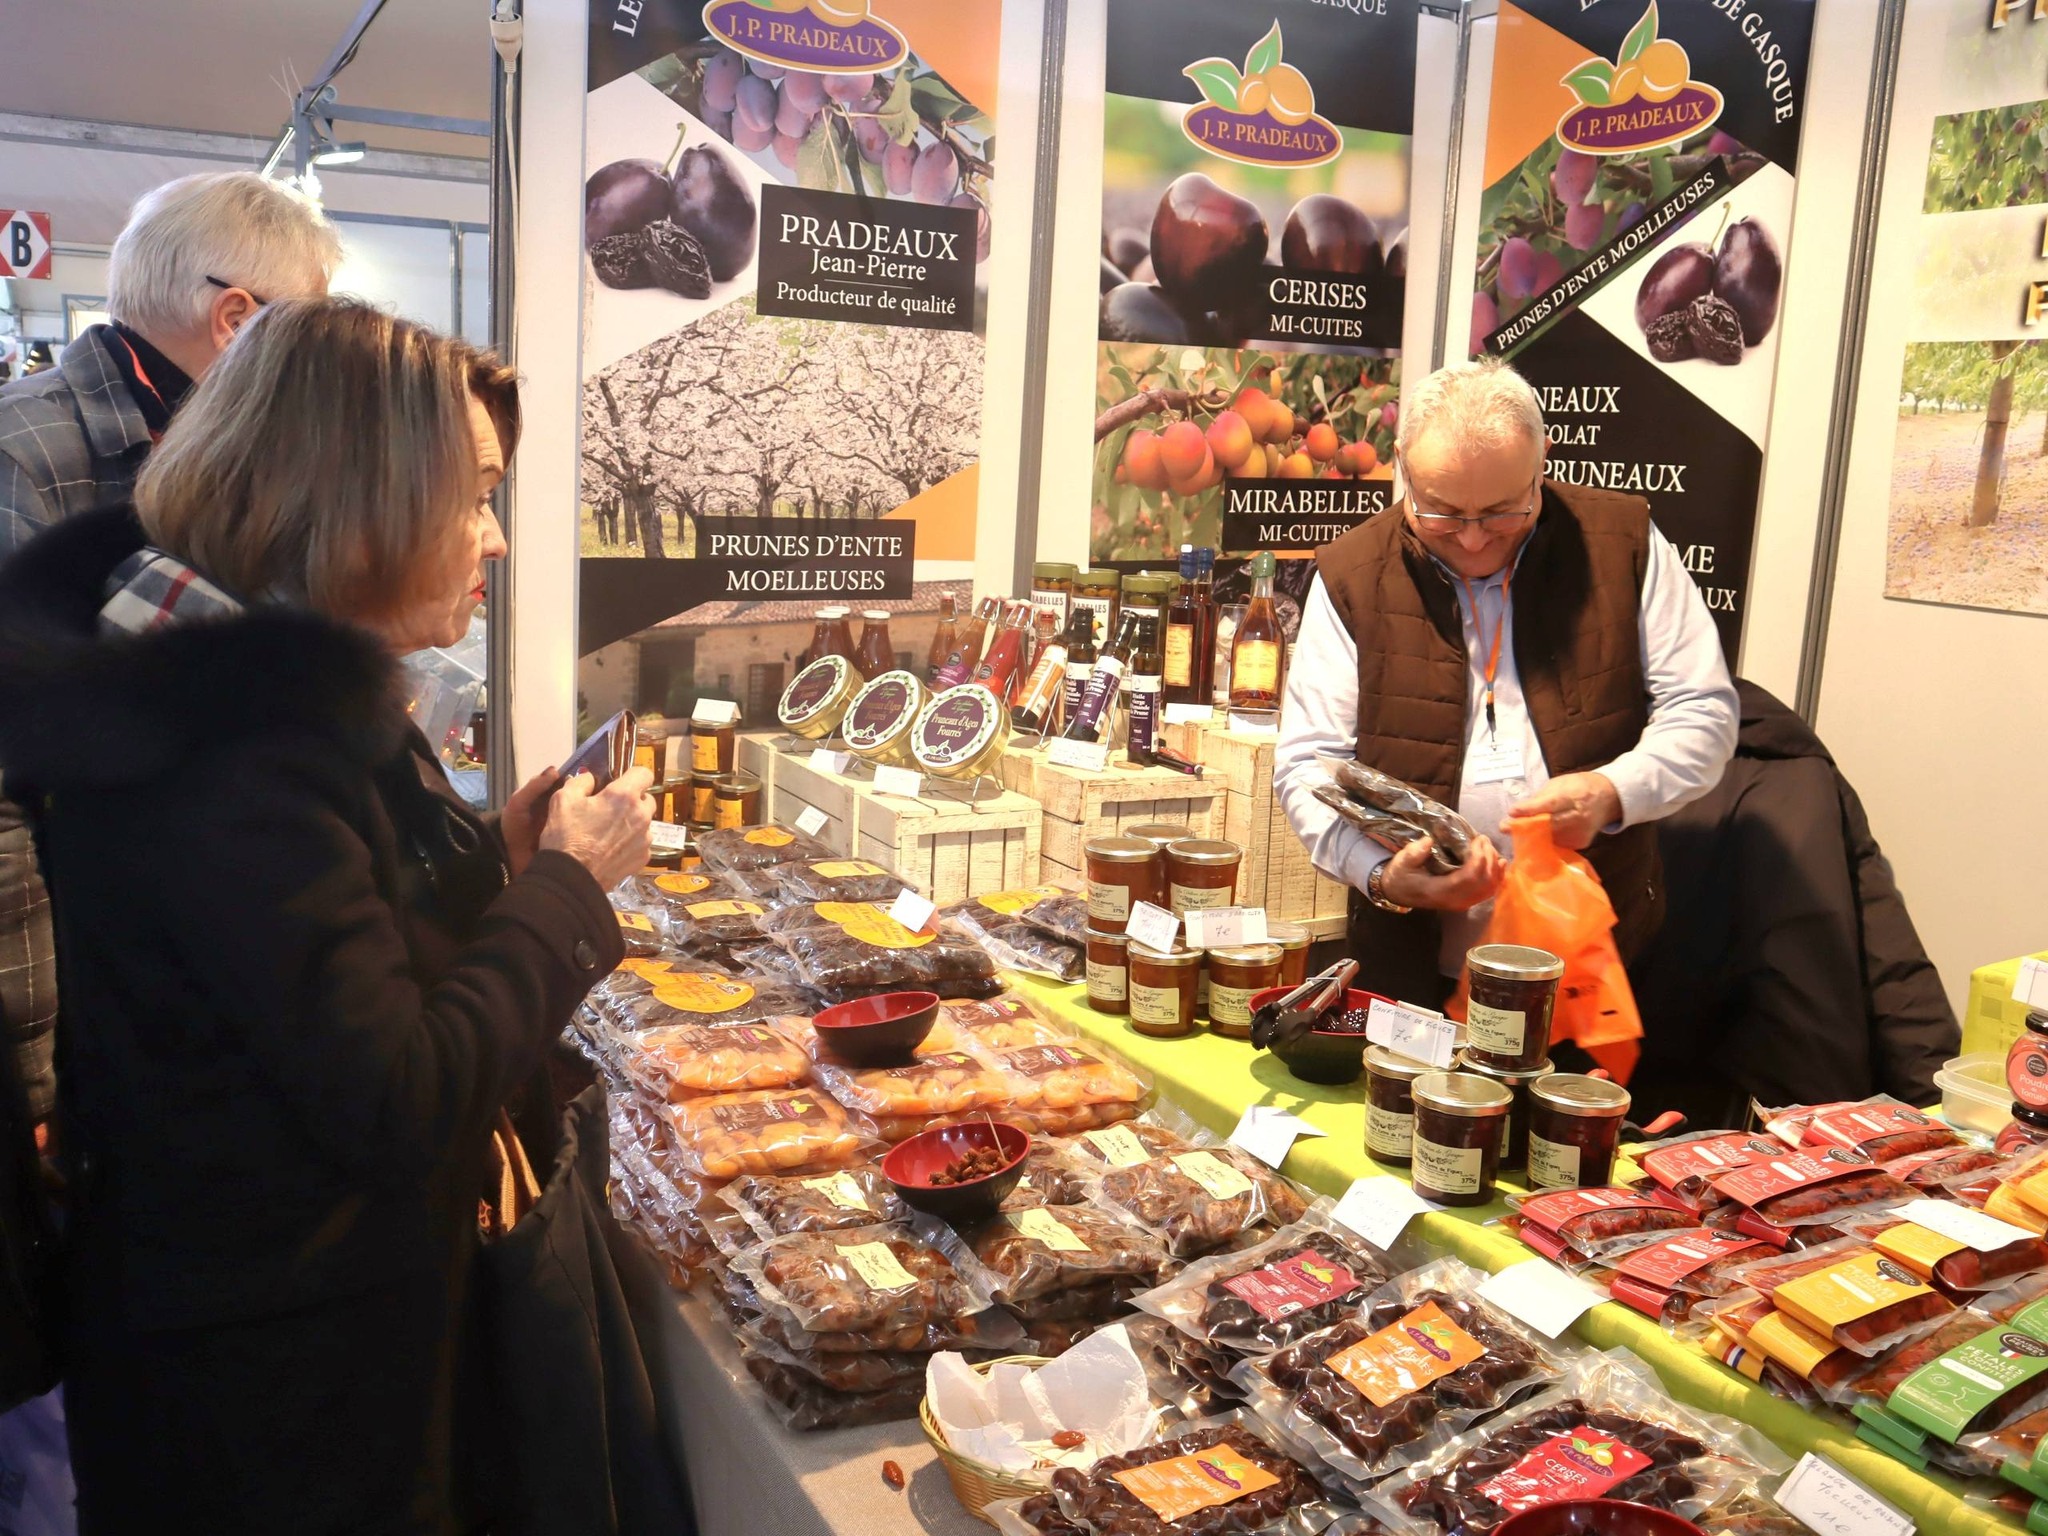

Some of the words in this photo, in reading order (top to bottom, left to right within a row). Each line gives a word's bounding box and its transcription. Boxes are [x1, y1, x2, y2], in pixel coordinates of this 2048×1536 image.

[728, 14, 743, 38] J.
[747, 17, 764, 40] P.
[769, 22, 890, 59] PRADEAUX
[1741, 12, 1794, 124] GASQUE
[1201, 118, 1214, 140] J.
[1217, 121, 1231, 140] P.
[1235, 122, 1328, 153] PRADEAUX
[1574, 120, 1587, 142] J.
[1589, 118, 1602, 137] P.
[1605, 99, 1705, 134] PRADEAUX
[11, 220, 32, 268] B
[778, 213, 959, 262] PRADEAUX
[811, 248, 927, 282] Jean-Pierre
[1495, 299, 1552, 350] PRUNES
[1553, 254, 1610, 307] D'ENTE
[1609, 172, 1717, 264] MOELLEUSES
[776, 281, 873, 309] Producteur
[876, 284, 898, 310] de
[901, 287, 957, 319] qualité
[1269, 277, 1367, 310] CERISES
[1269, 313, 1363, 339] MI-CUITES
[1228, 489, 1385, 515] MIRABELLES
[709, 533, 810, 557] PRUNES
[815, 535, 902, 558] D'ENTE
[725, 569, 886, 592] MOELLEUSES
[930, 712, 959, 726] Pruneaux
[958, 715, 979, 731] d'Agen
[936, 725, 963, 738] Fourrés
[1504, 1039, 1520, 1047] 375g
[1461, 1177, 1477, 1185] 375g
[1559, 1174, 1576, 1183] 375g
[1383, 1334, 1434, 1376] MIRABELLES
[1545, 1458, 1588, 1485] CERISES
[1854, 1494, 1872, 1506] DE
